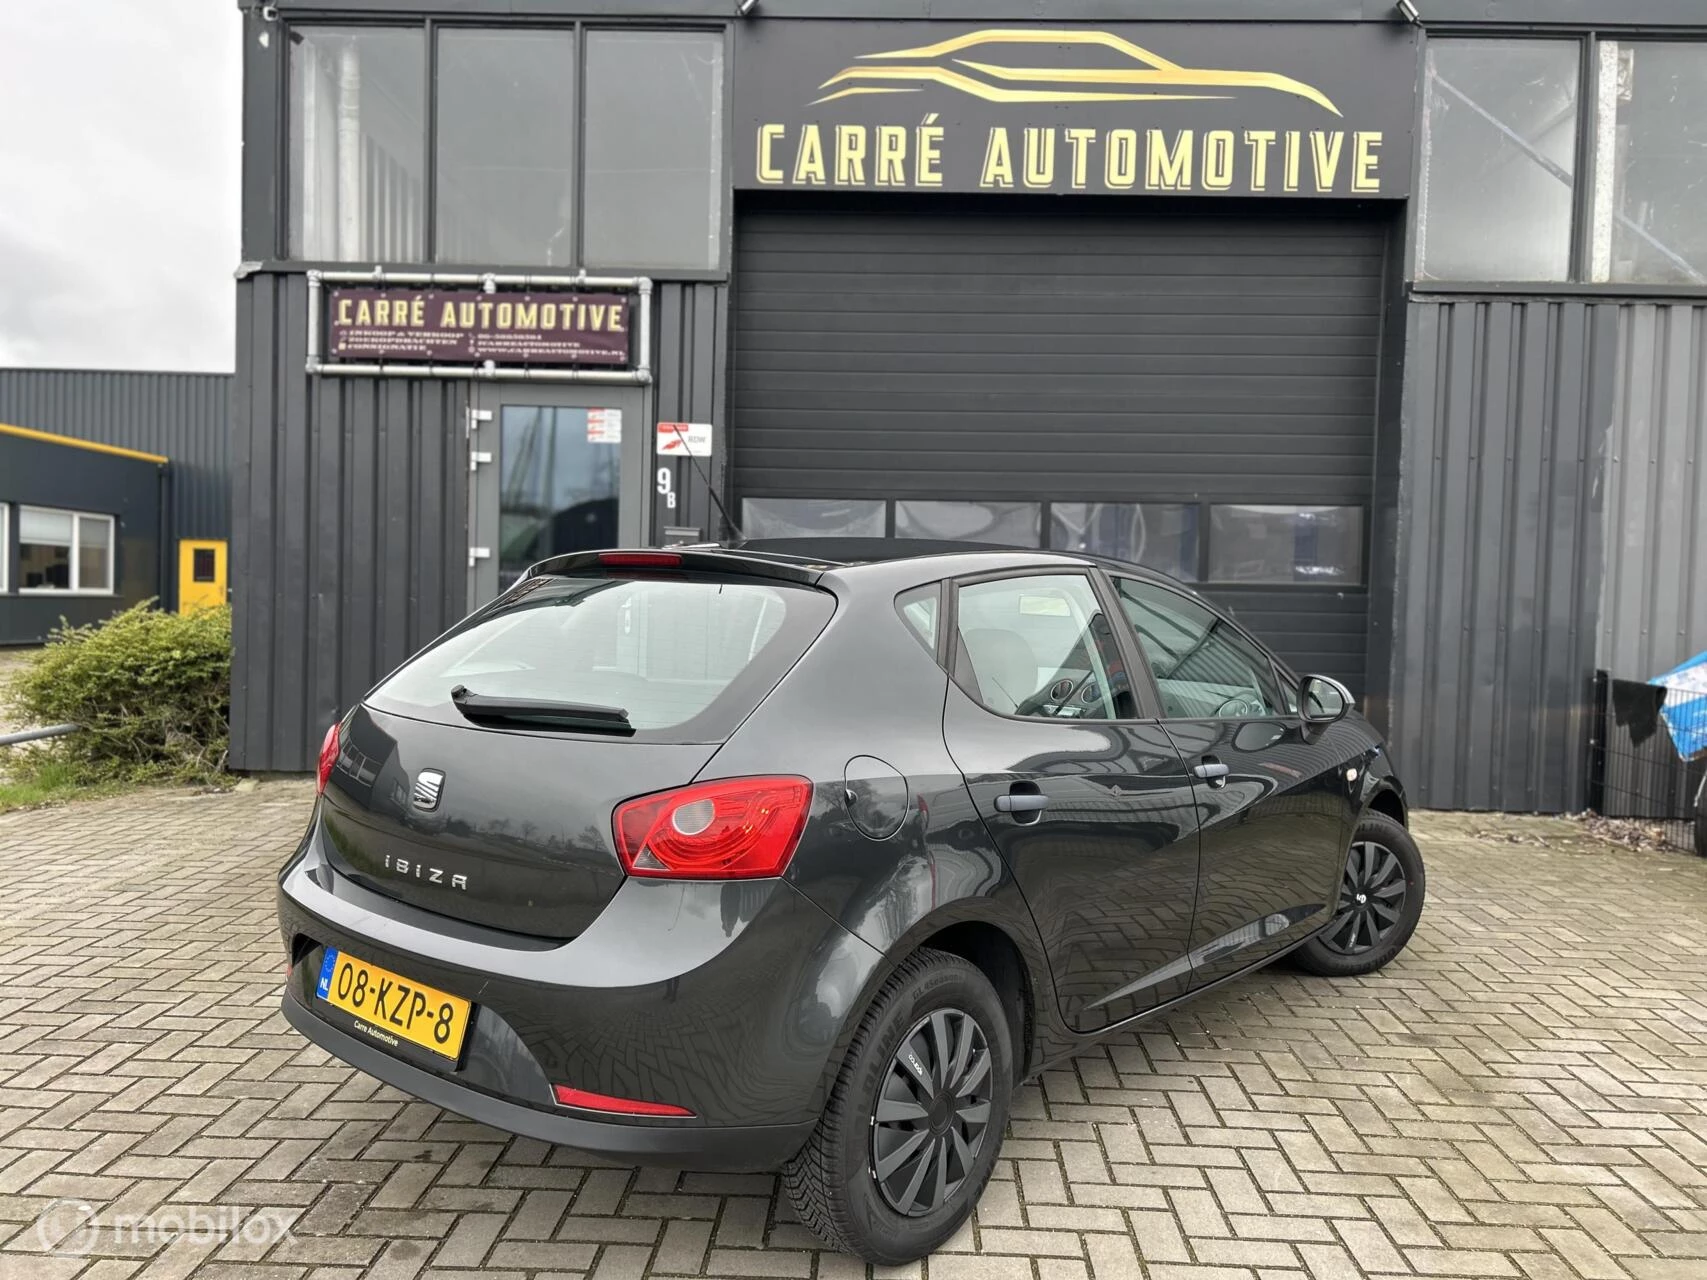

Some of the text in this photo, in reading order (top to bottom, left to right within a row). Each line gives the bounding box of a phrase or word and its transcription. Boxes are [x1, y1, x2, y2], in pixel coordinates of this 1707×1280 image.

[756, 113, 1384, 194] CARRÉ AUTOMOTIVE
[338, 296, 623, 331] CARRÉ AUTOMOTIVE
[320, 978, 329, 991] NL
[337, 962, 454, 1044] 08-KZP-8
[353, 1020, 399, 1047] Carre Automotive
